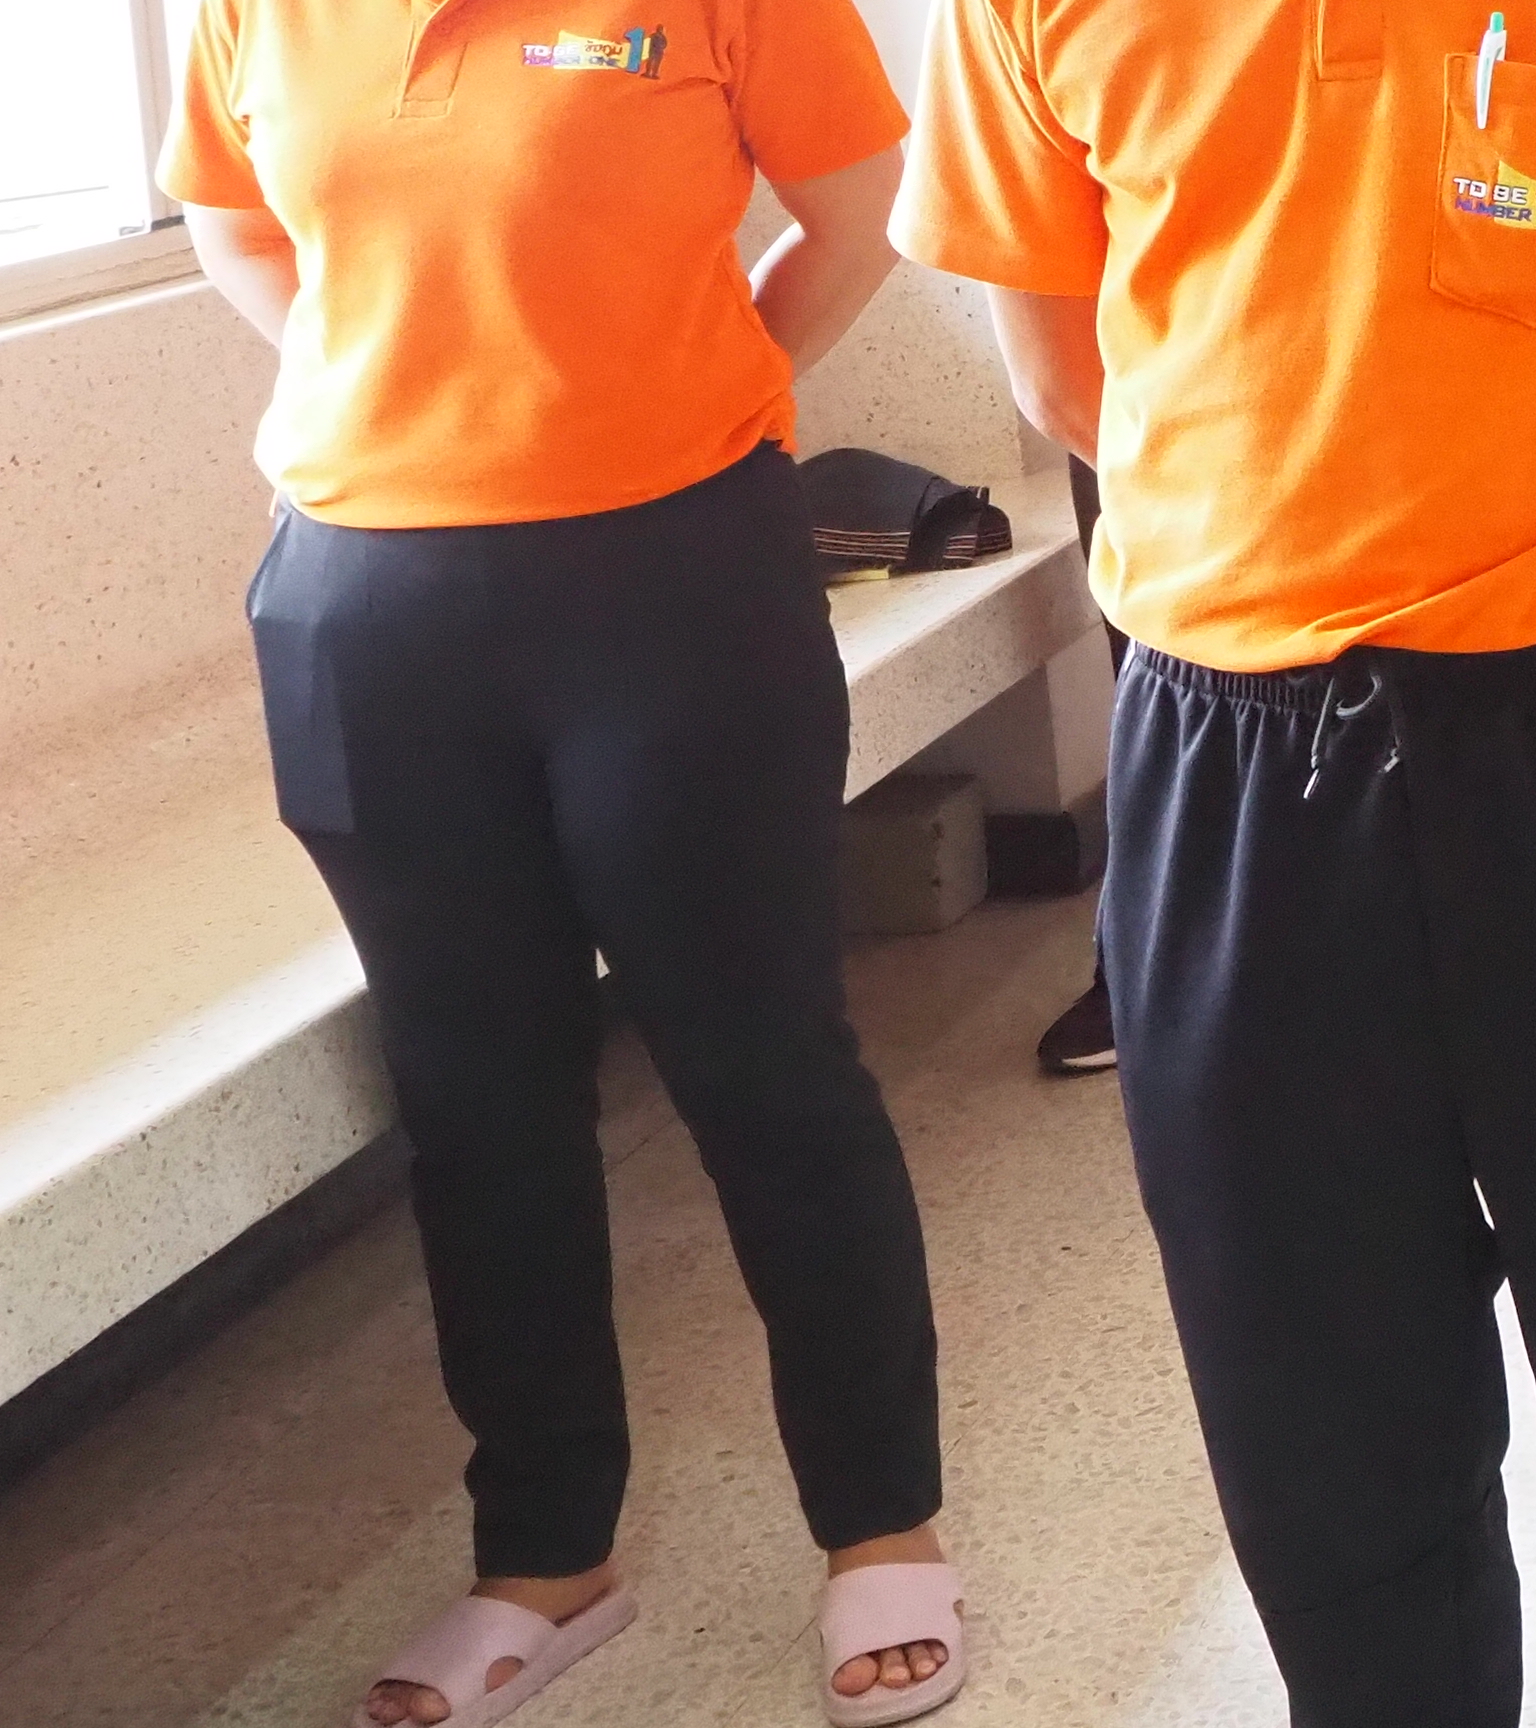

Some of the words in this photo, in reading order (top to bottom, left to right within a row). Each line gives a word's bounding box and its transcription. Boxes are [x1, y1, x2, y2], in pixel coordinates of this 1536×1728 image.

[1453, 177, 1487, 199] TO
[1493, 184, 1529, 205] BE
[1454, 197, 1532, 223] NUMBER
